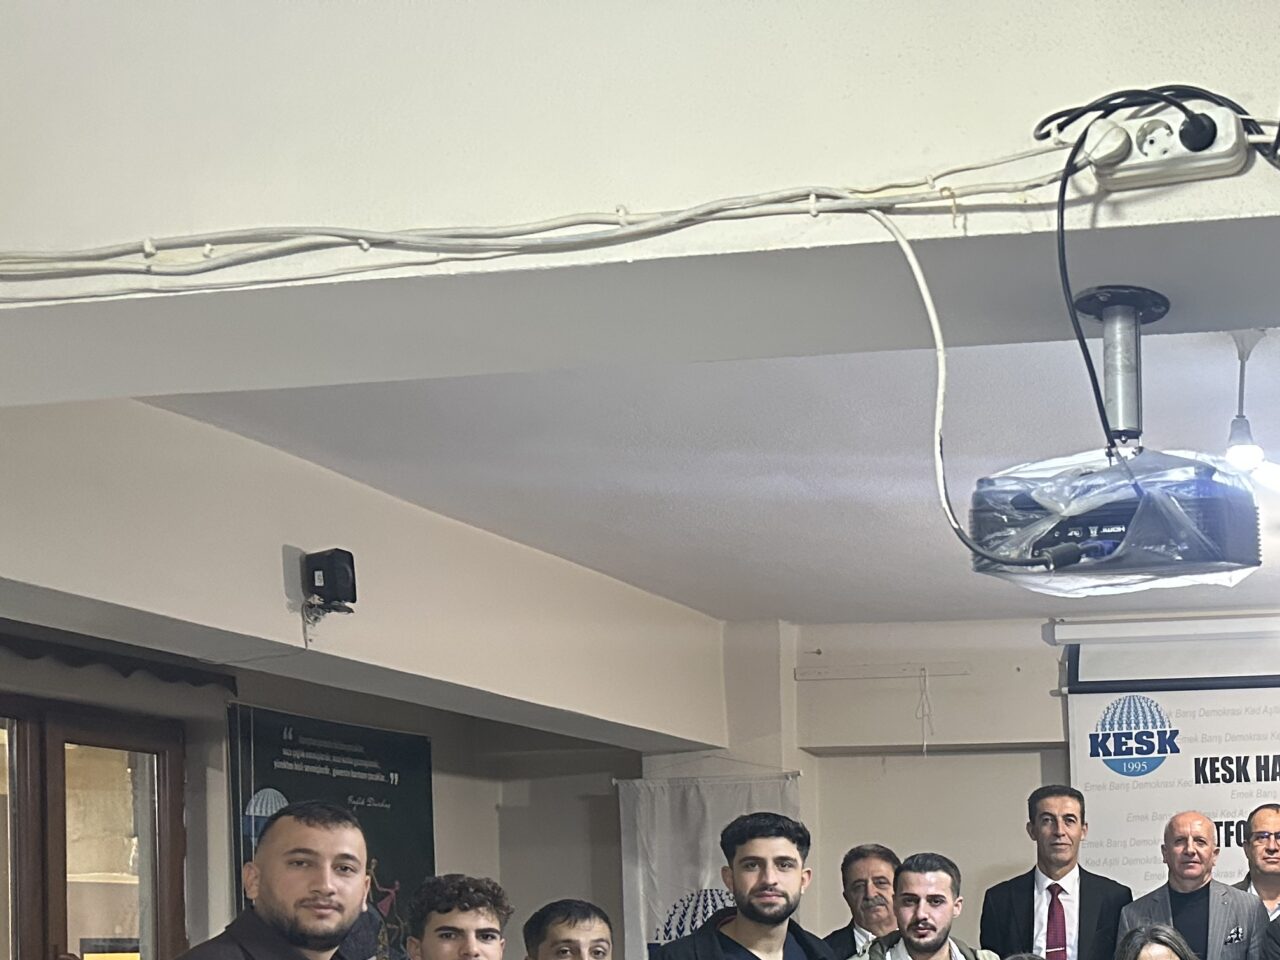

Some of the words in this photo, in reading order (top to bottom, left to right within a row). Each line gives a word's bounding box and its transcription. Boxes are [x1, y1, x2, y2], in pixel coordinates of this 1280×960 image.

[1089, 729, 1180, 757] KESK
[1122, 761, 1148, 773] 1995
[1194, 756, 1250, 784] KESK
